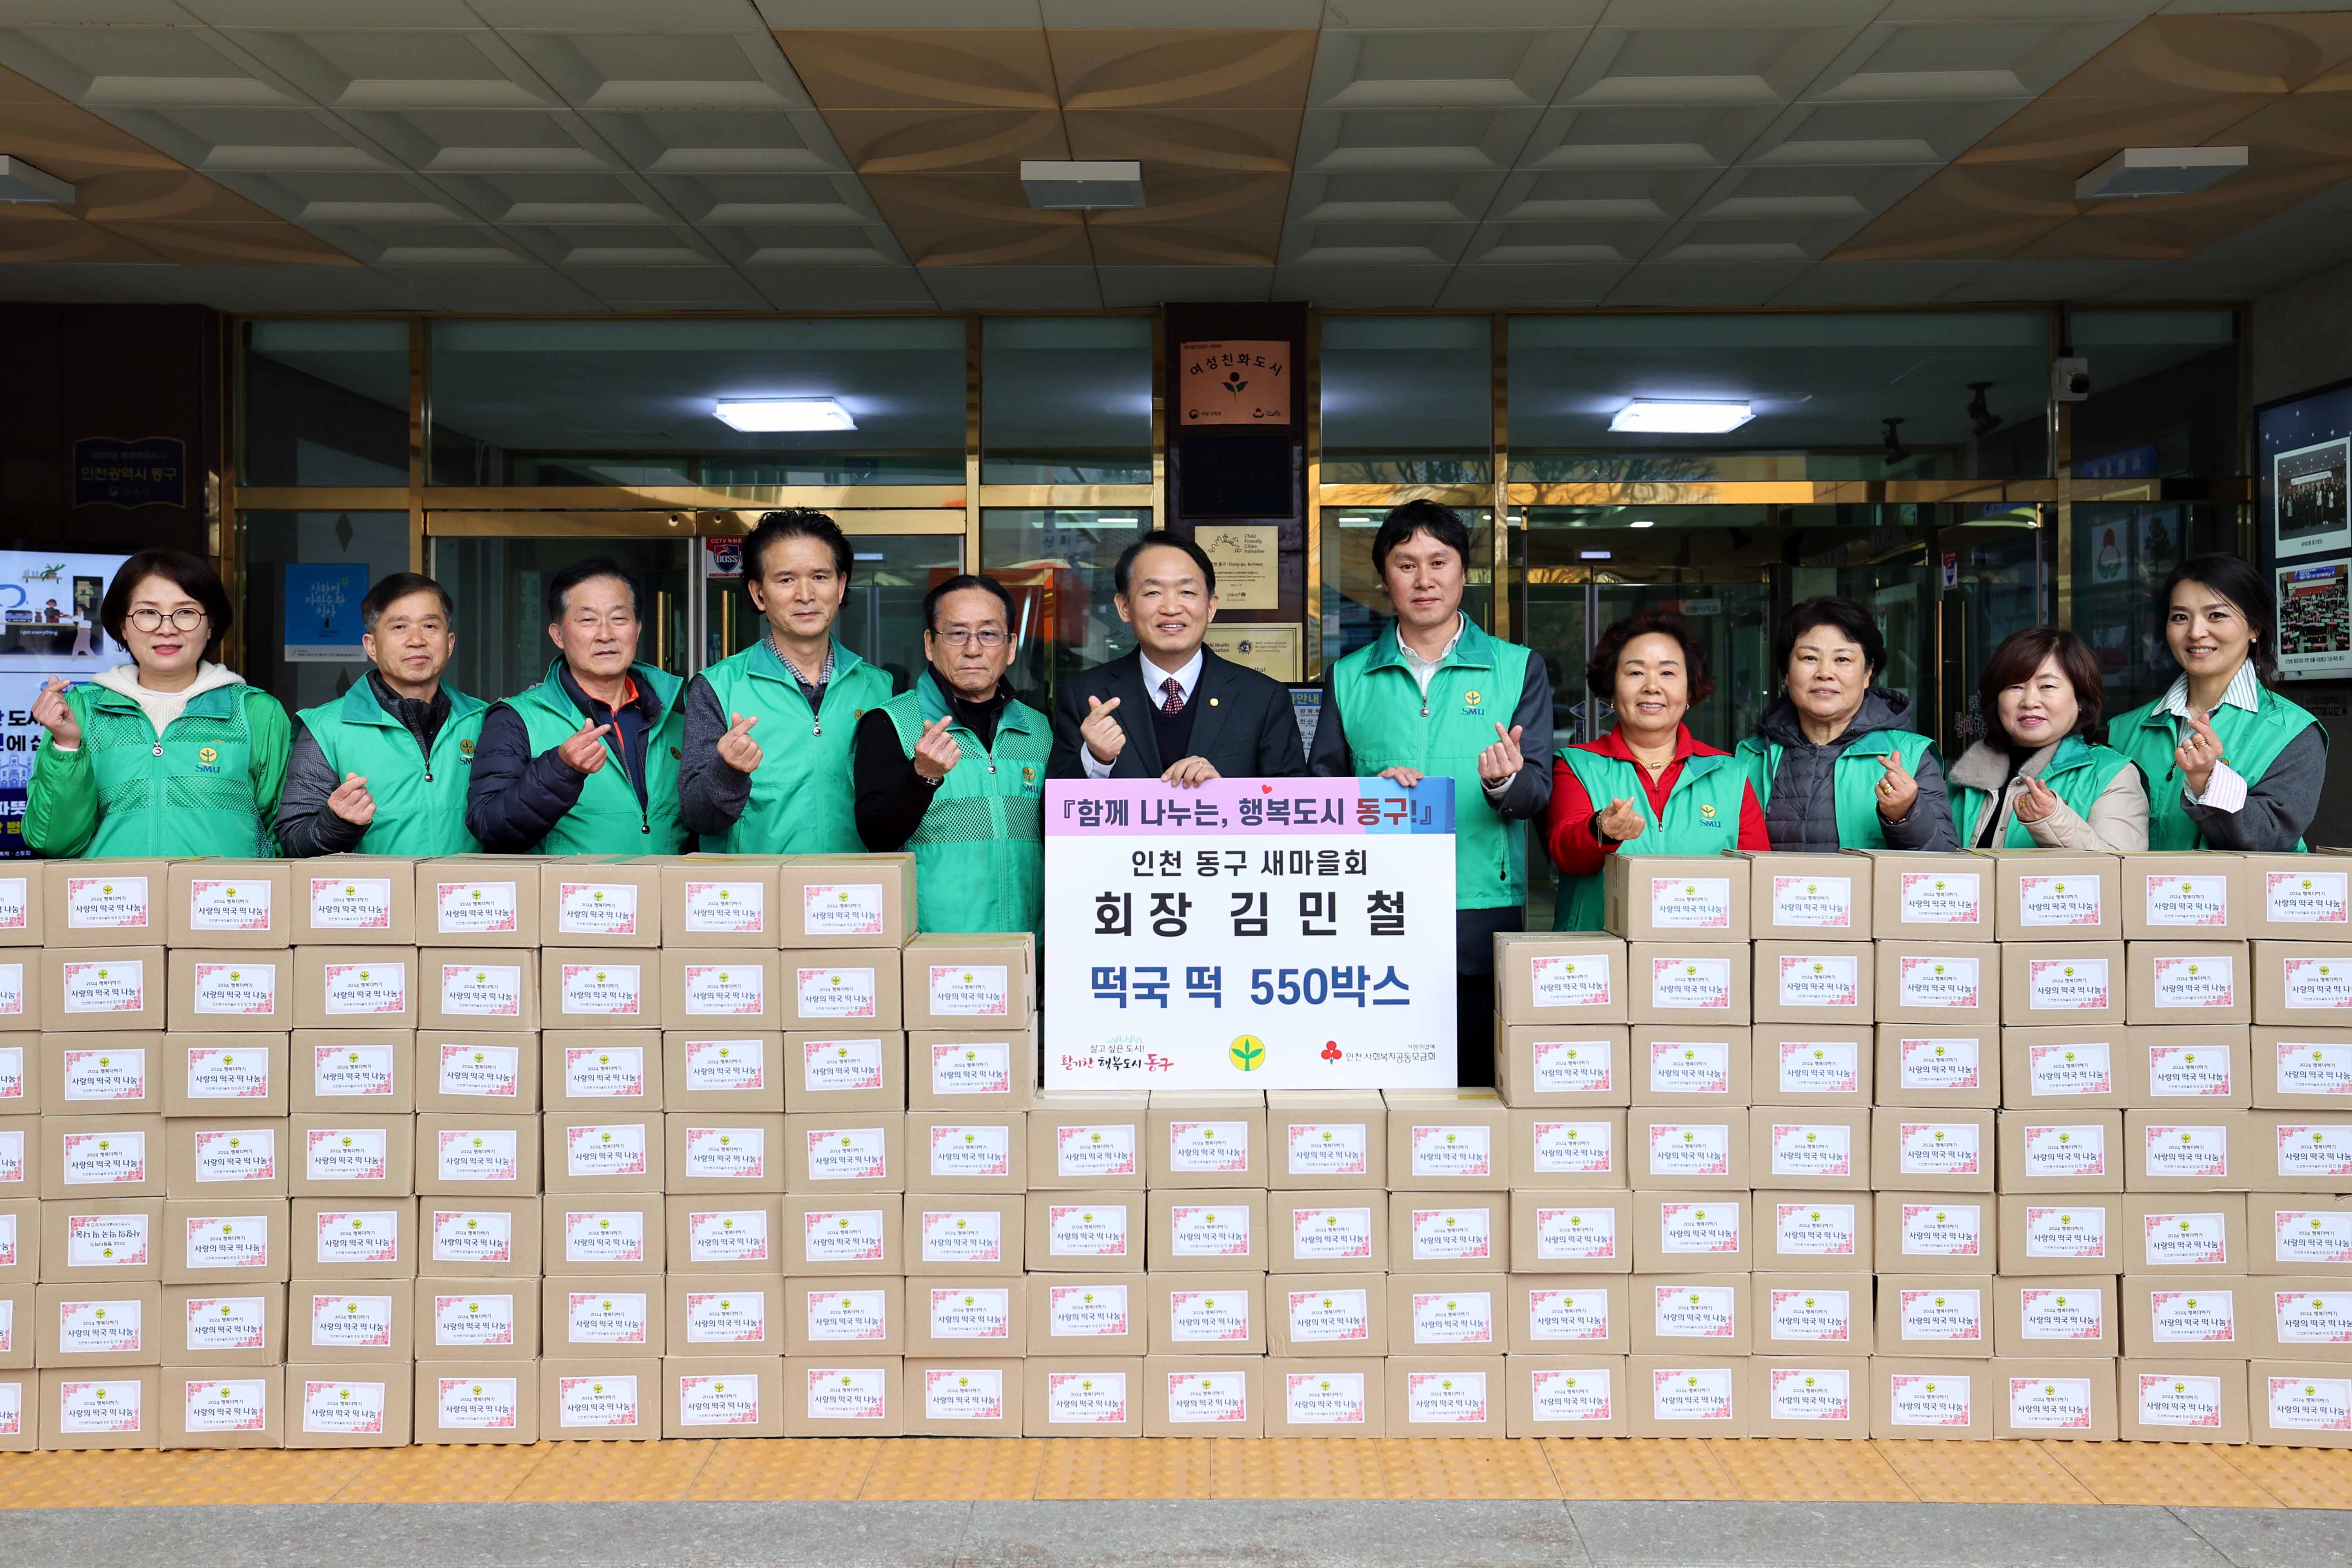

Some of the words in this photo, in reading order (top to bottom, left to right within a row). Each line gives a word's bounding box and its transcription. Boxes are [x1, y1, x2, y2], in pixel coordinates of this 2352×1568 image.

[1191, 353, 1282, 376] 여성친화도시
[81, 467, 147, 482] 인천광역시
[151, 467, 178, 483] 동구
[1064, 799, 1129, 827] 『함께
[1141, 799, 1228, 828] 나누는,
[1239, 798, 1344, 826] 행복도시
[1356, 798, 1432, 826] 동구!』
[1132, 850, 1181, 877] 인천
[1196, 850, 1247, 877] 동구
[1261, 849, 1367, 876] 새마을회
[4, 905, 20, 914] 나눔
[1094, 891, 1192, 937] 회장
[1091, 966, 1170, 1009] 떡국
[1186, 966, 1221, 1008] 떡
[1250, 965, 1410, 1008] 550박스
[1908, 984, 1929, 992] 사랑의
[1090, 1044, 1106, 1053] 살고
[1108, 1044, 1124, 1053] 싶은
[1125, 1044, 1144, 1053] 도시!
[1060, 1055, 1094, 1070] 활기찬
[1097, 1056, 1142, 1071] 행복도시
[1143, 1053, 1174, 1072] 동구
[1346, 1052, 1362, 1061] 인천
[1364, 1052, 1435, 1063] 사회복지공동모금회
[2277, 1406, 2299, 1414] 사랑의
[2301, 1406, 2317, 1414] 떡국
[2329, 1407, 2343, 1415] 나눔
